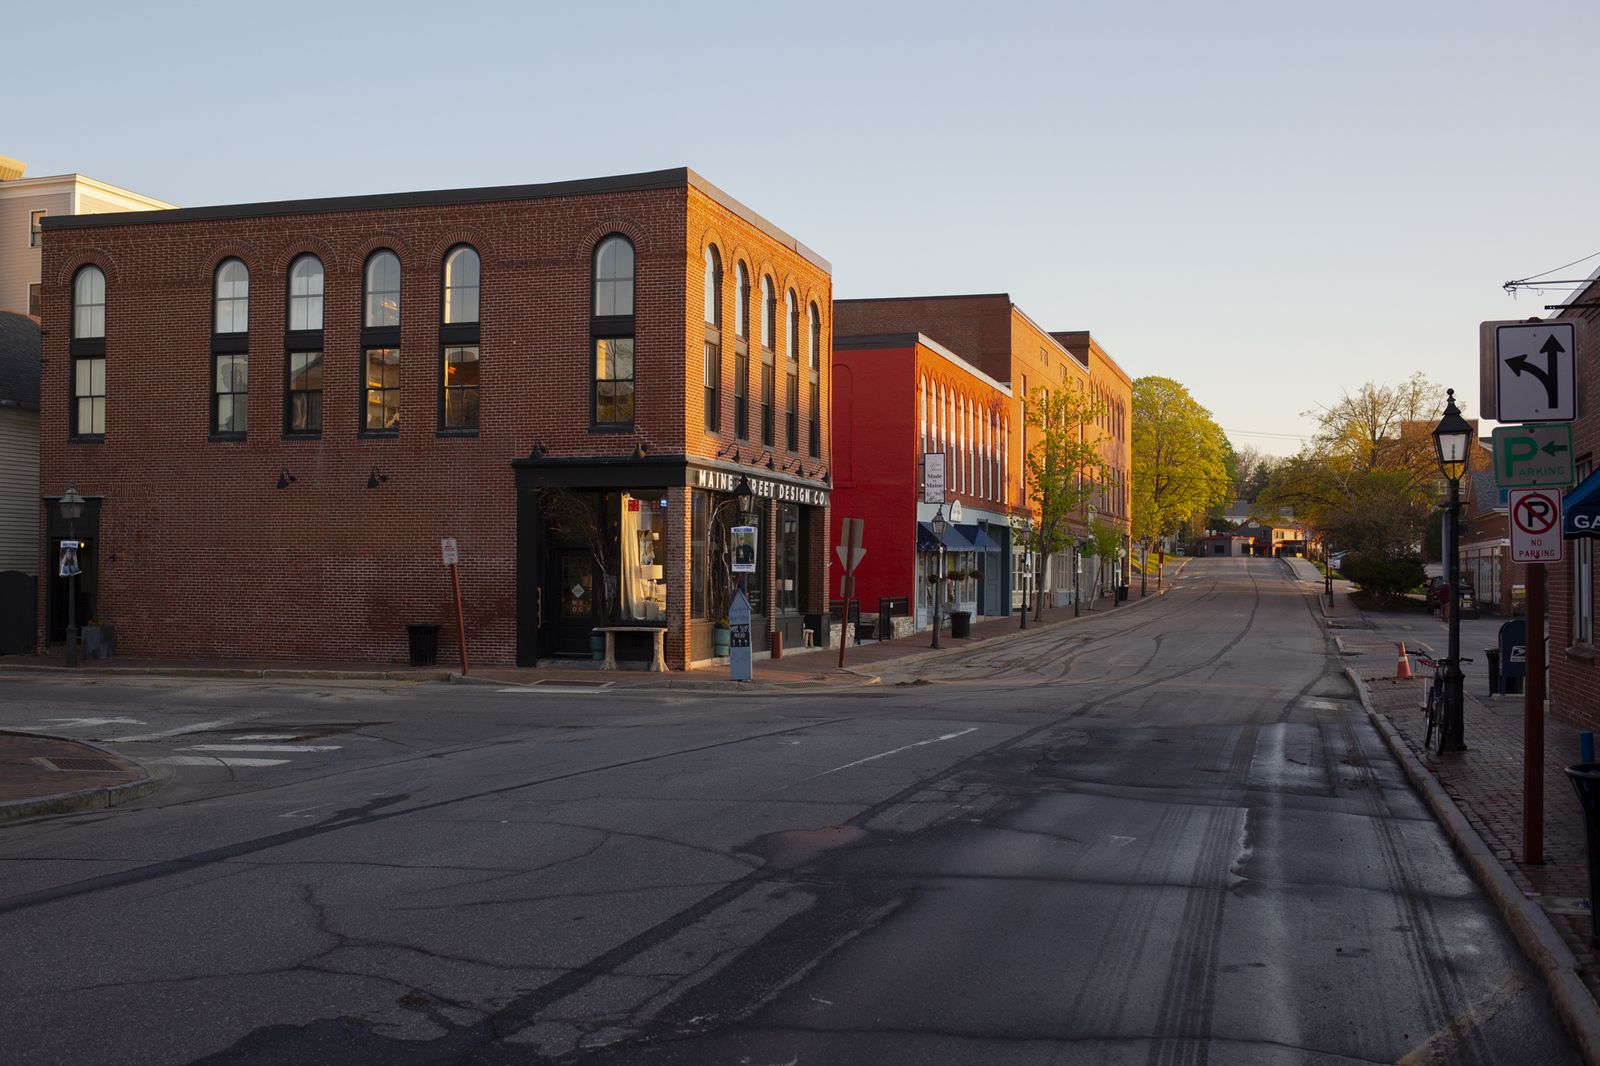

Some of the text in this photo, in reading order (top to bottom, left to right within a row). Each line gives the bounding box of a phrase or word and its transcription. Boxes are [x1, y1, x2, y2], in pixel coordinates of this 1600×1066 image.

[1504, 436, 1565, 478] PARKING
[699, 470, 733, 491] MAINE
[738, 476, 775, 498] REET
[779, 483, 811, 503] DESIGN
[1530, 539, 1543, 547] NO
[1519, 550, 1555, 558] PARKING
